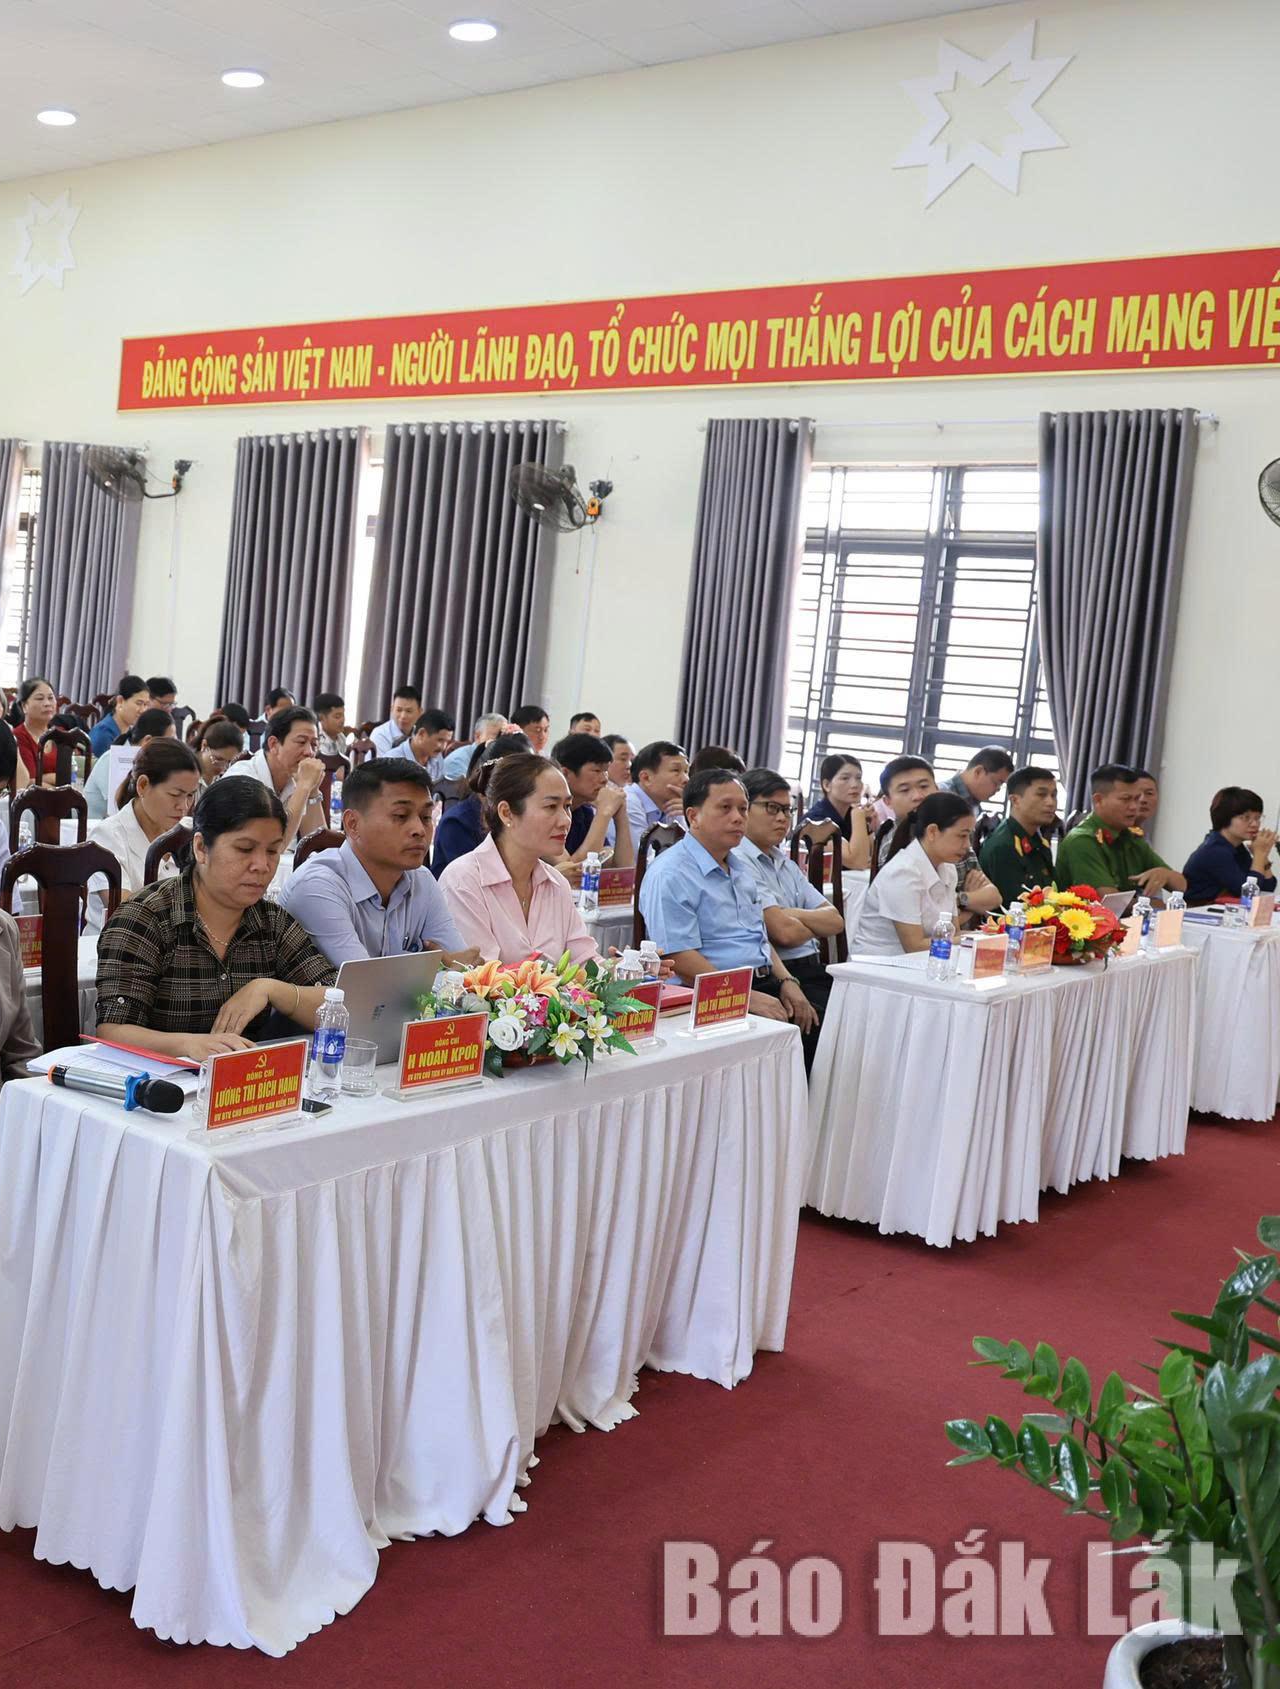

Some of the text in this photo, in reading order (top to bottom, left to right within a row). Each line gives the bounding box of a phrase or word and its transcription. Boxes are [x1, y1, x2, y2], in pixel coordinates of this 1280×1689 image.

[142, 344, 187, 398] ĐẢNG
[190, 346, 238, 403] CỘNG
[240, 336, 278, 394] SẢN
[283, 337, 325, 399] VIỆT
[329, 345, 373, 388] NAM
[390, 328, 453, 386] NGƯỜI
[459, 325, 518, 382] LÃNH
[525, 332, 579, 388] ĐẠO,
[588, 303, 625, 377] TỔ
[628, 311, 697, 374] CHỨC
[704, 319, 758, 381] MỌI
[766, 293, 862, 368] THẮNG
[869, 301, 922, 374] LỢI
[929, 285, 992, 364] CỦA
[1004, 286, 1096, 359] CÁCH
[1106, 289, 1215, 364] MẠNG
[407, 1053, 416, 1070] H
[418, 1049, 449, 1068] NOAN
[243, 1083, 256, 1104] THỊ
[257, 1079, 277, 1100] BÍCH
[278, 1075, 299, 1097] HẠNH
